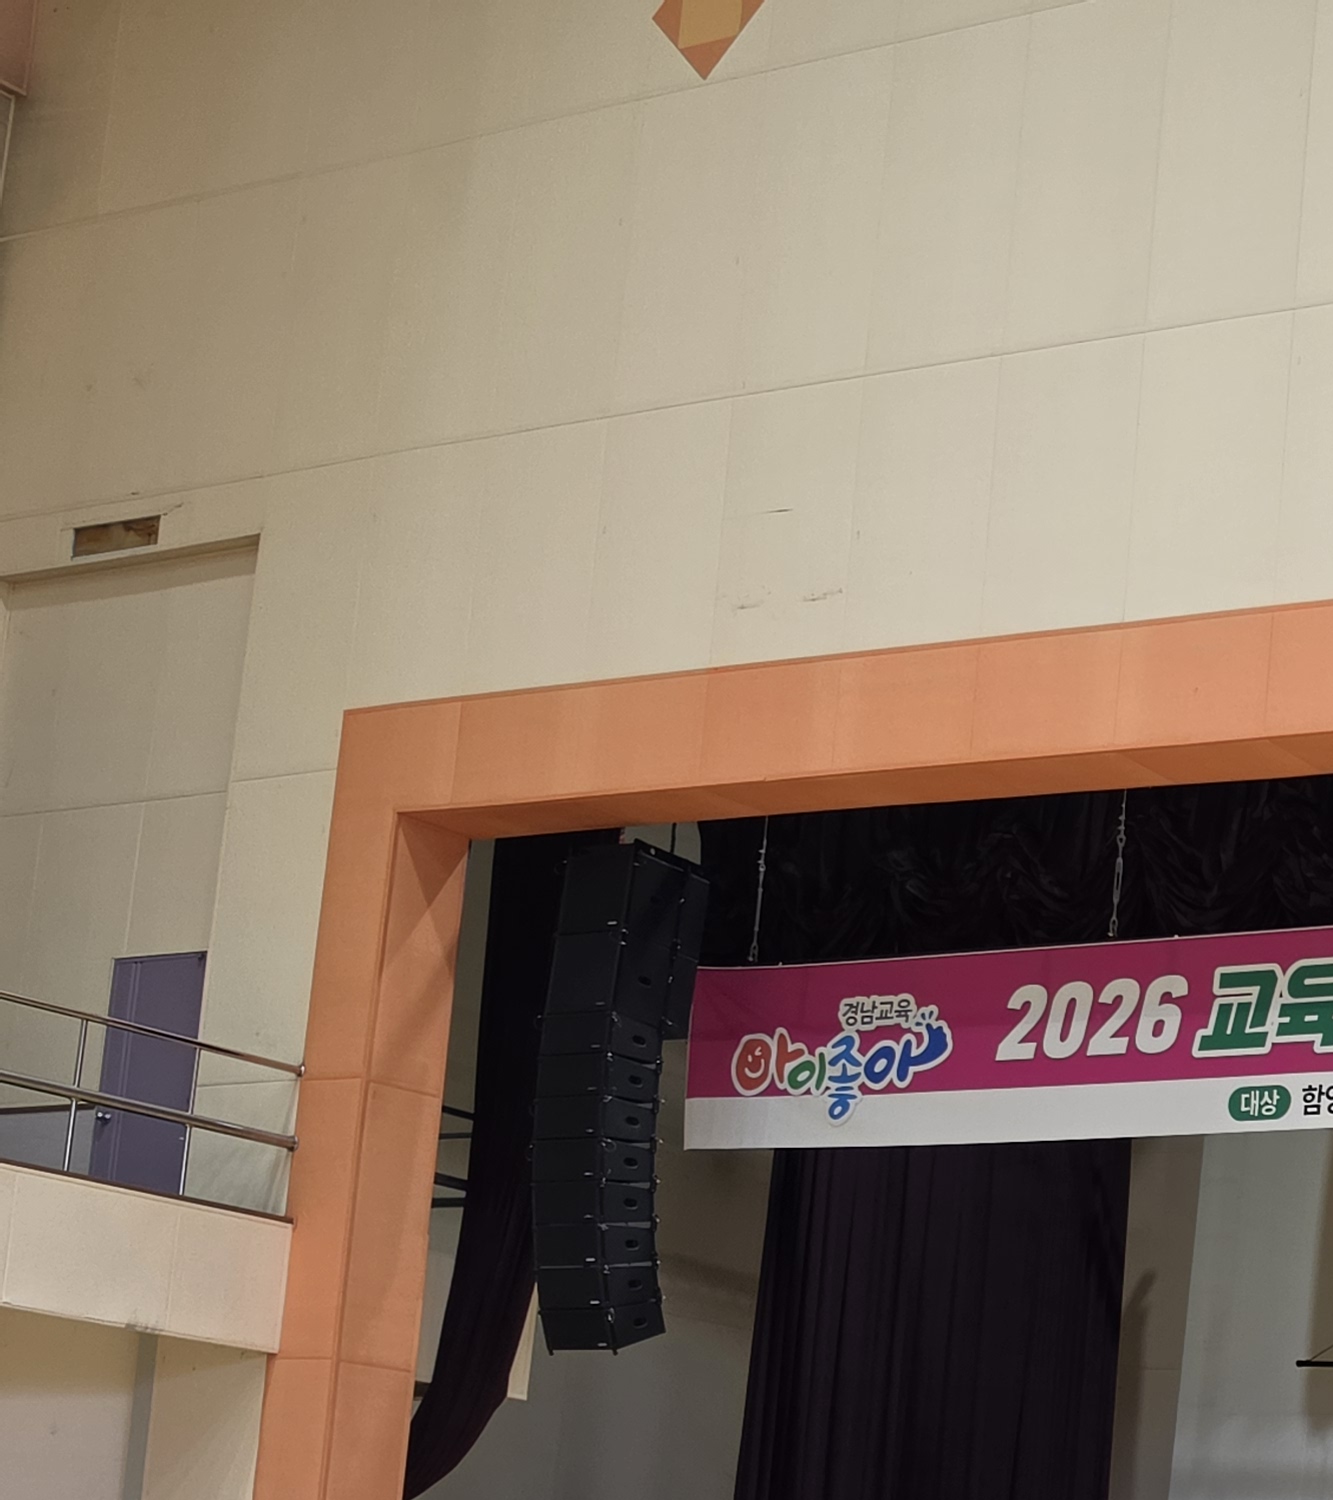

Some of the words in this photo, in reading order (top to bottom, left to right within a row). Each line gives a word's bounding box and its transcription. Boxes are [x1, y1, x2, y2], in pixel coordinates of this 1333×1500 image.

[842, 999, 912, 1026] 경남교육
[995, 974, 1189, 1061] 2026
[735, 1024, 949, 1120] 아이좋아
[1239, 1089, 1280, 1116] 대상
